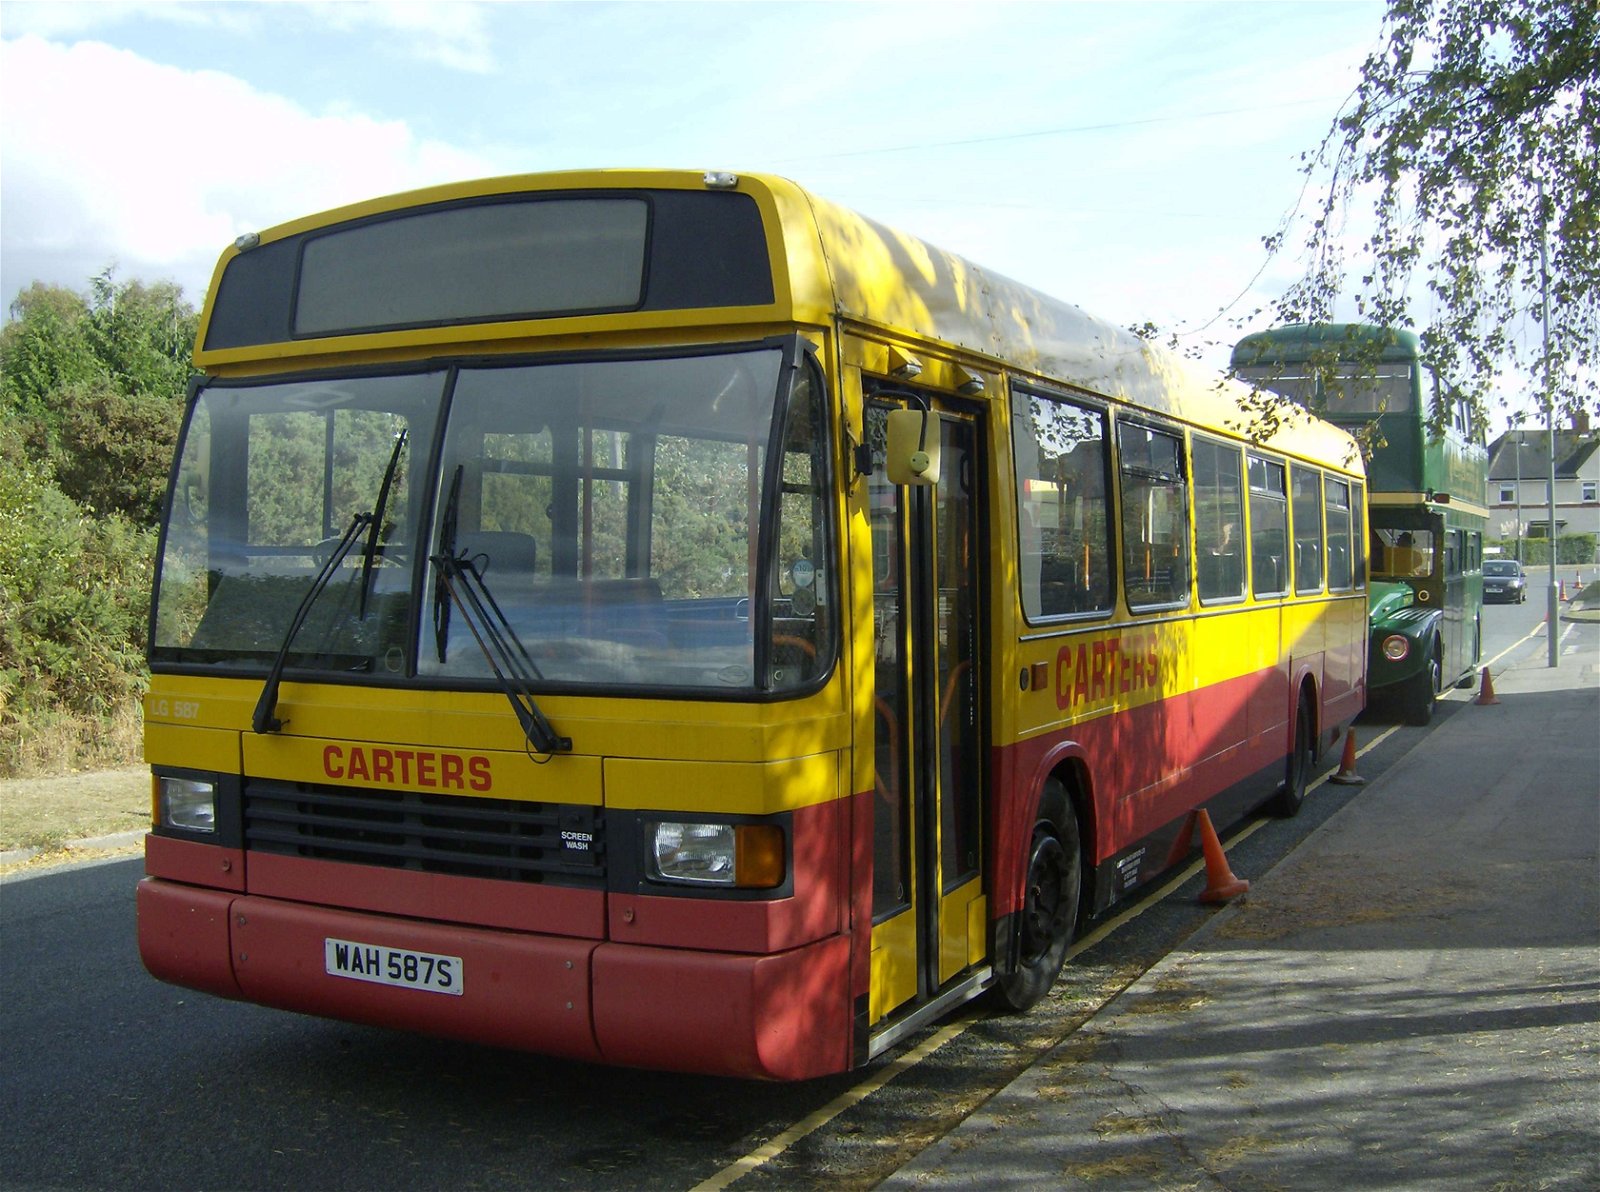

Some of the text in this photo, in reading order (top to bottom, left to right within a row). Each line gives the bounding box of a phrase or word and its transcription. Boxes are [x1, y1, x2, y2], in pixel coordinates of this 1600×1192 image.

[1056, 632, 1158, 711] CARTERS
[151, 699, 199, 719] LG 587
[323, 745, 492, 791] CARTERS
[561, 831, 592, 841] SCREEN
[565, 841, 588, 850] WASH
[335, 943, 452, 987] WAH 587S
